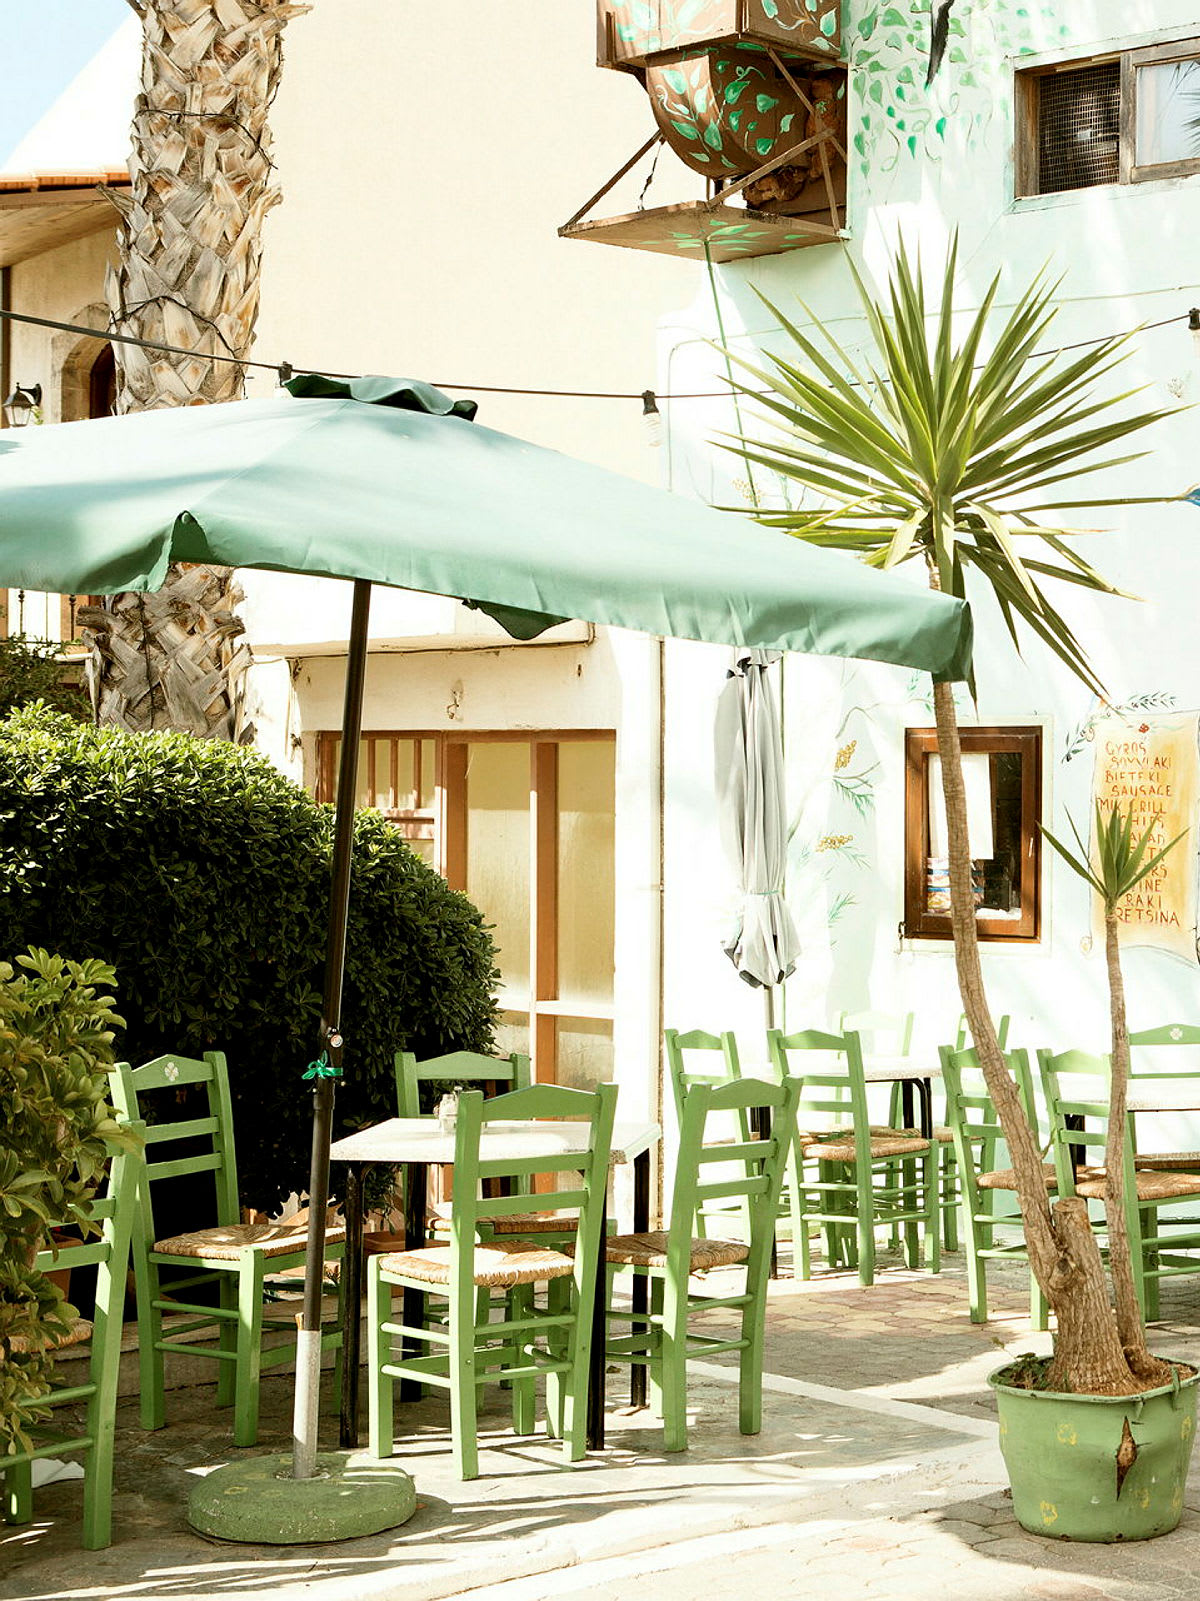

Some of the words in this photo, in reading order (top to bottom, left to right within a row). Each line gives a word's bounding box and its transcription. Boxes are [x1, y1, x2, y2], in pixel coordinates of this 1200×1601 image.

[1105, 741, 1147, 756] GYROS
[1125, 893, 1162, 909] RAKI
[1116, 907, 1180, 927] RETSINA
